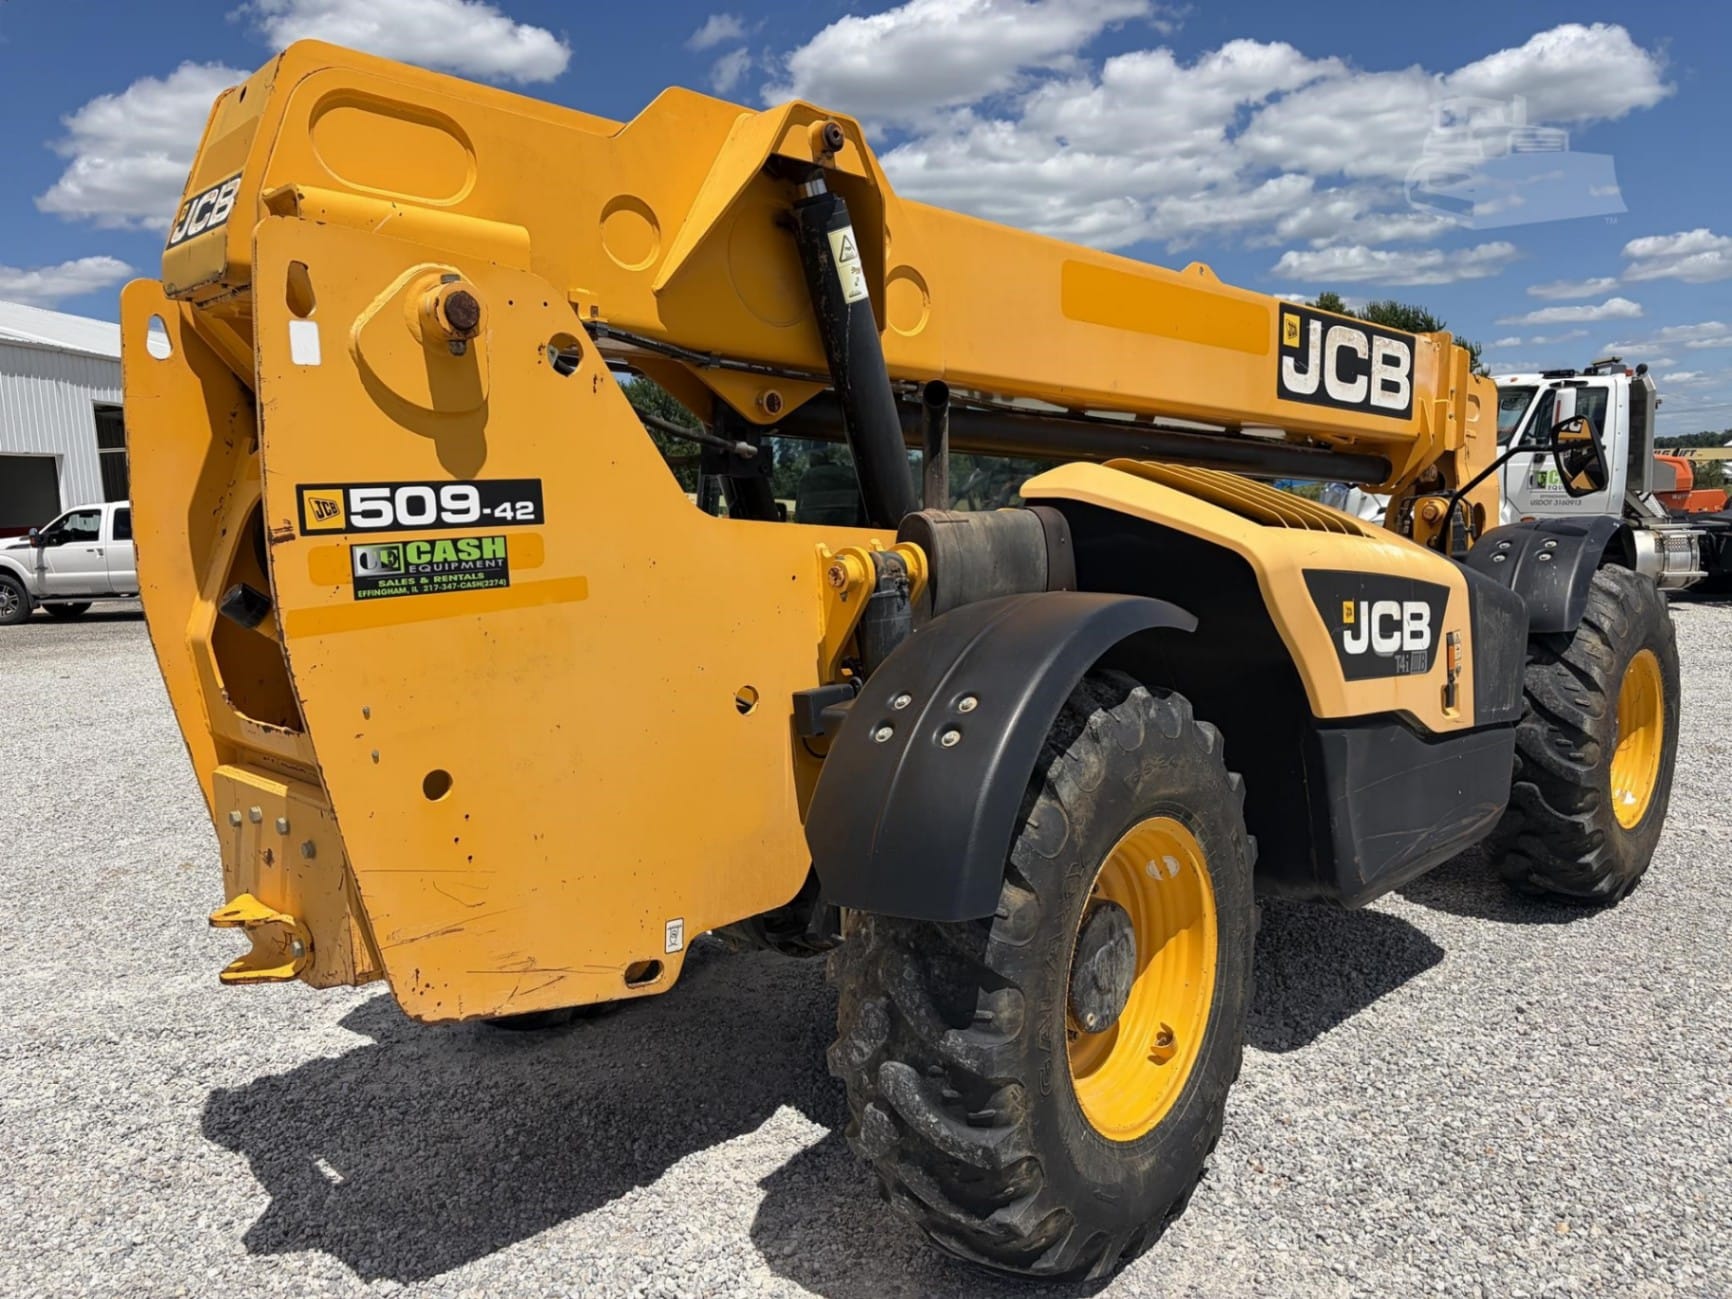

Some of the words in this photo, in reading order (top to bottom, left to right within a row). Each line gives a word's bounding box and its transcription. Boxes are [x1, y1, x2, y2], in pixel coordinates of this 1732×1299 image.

[171, 177, 241, 244] JCB
[1282, 318, 1411, 411] JCB
[314, 500, 338, 519] JCB
[349, 485, 535, 528] 509-42
[406, 536, 505, 565] CASH
[378, 578, 415, 588] SALES
[420, 576, 429, 584] &
[433, 572, 485, 583] RENTALS
[408, 559, 504, 573] EQUIPMENT
[357, 586, 410, 598] EFFINGHAM,
[411, 585, 418, 593] IL
[1343, 601, 1431, 655] JCB
